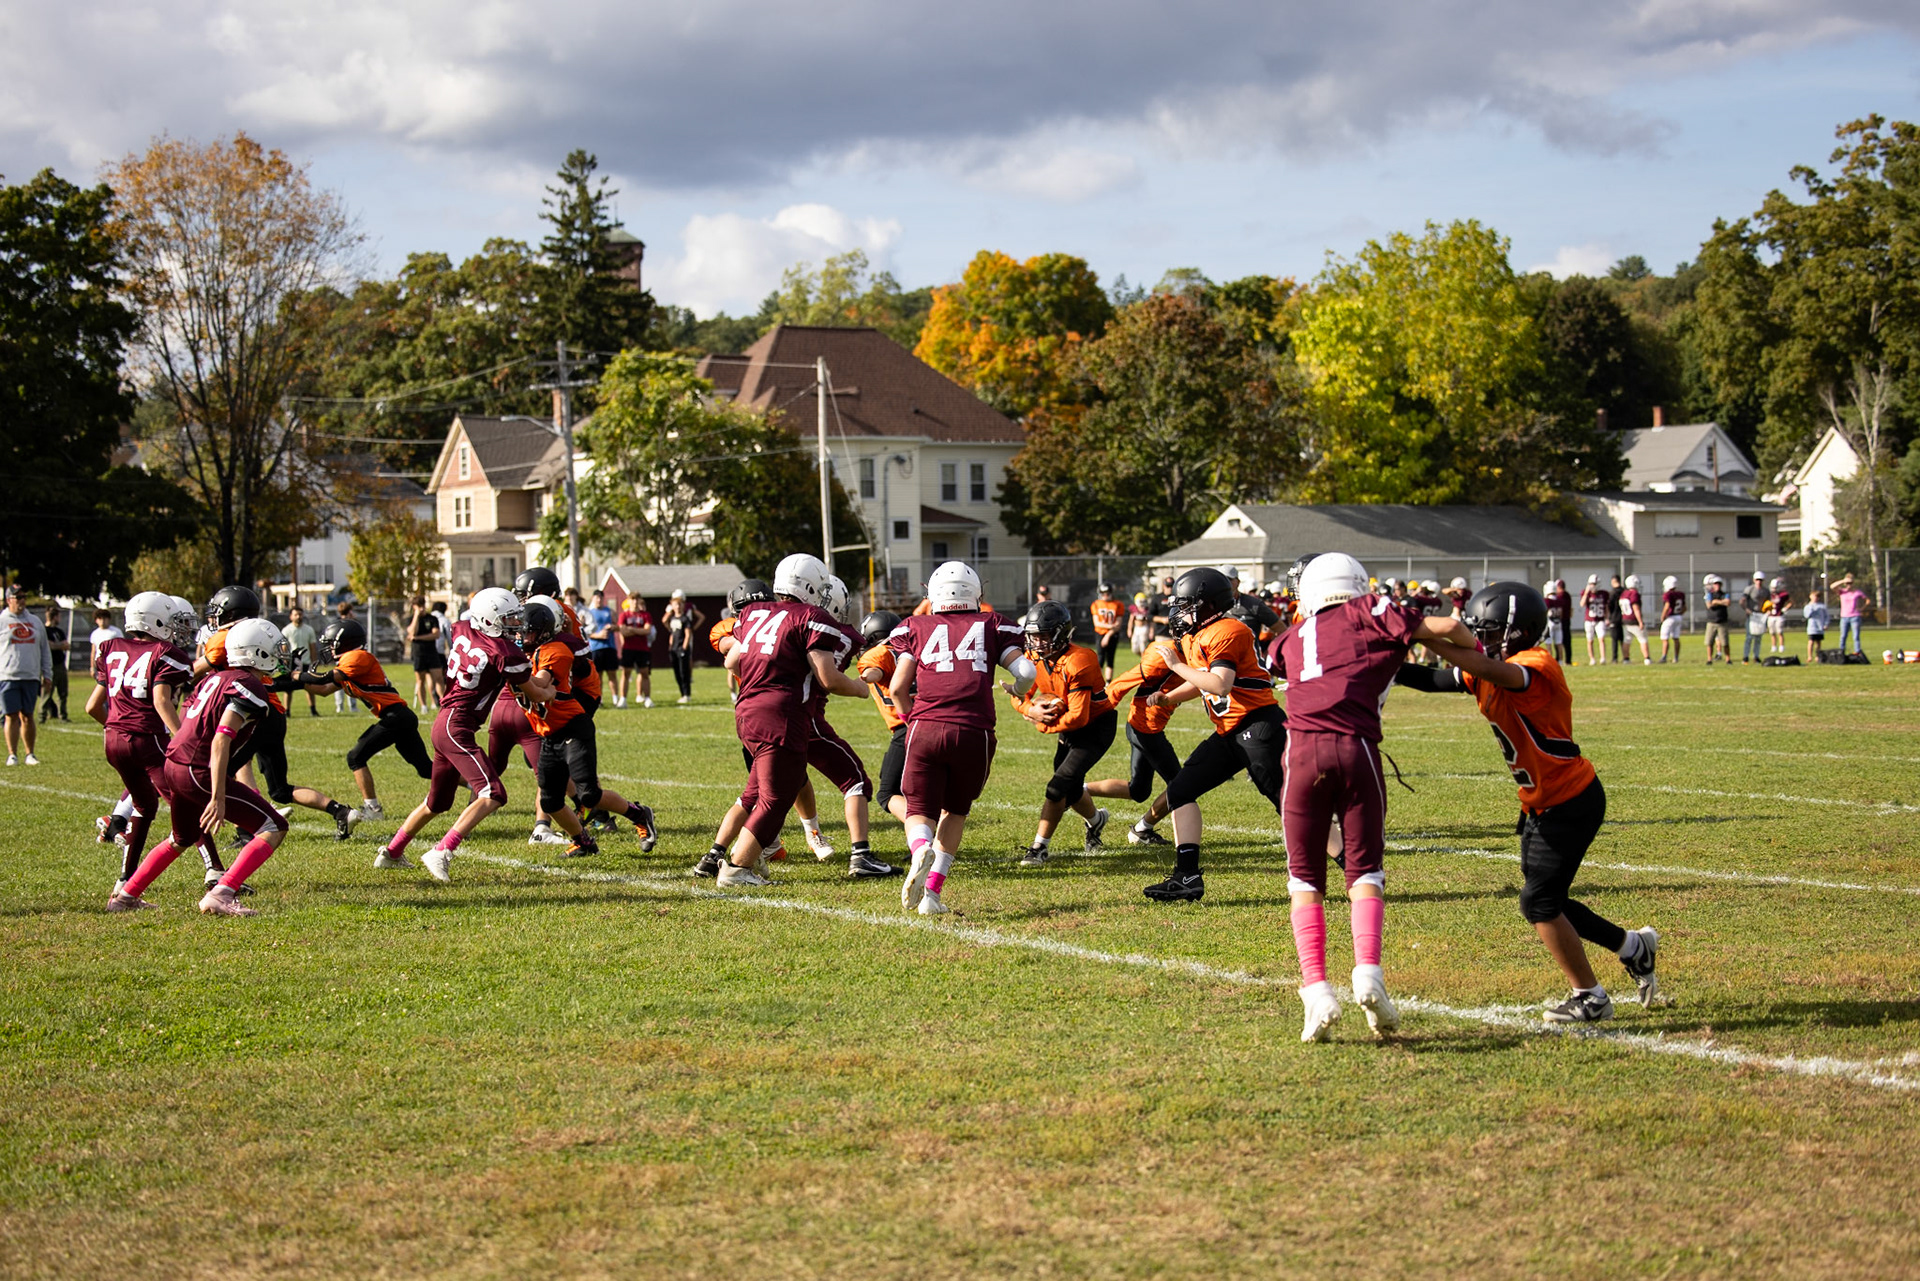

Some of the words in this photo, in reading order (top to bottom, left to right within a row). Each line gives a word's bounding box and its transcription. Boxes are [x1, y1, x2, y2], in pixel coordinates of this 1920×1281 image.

[941, 603, 968, 611] Riddell
[1674, 599, 1683, 614] 2
[740, 609, 789, 655] 74
[920, 621, 988, 673] 44
[1298, 616, 1323, 682] 1
[105, 651, 153, 699] 34
[446, 634, 489, 690] 63
[186, 676, 221, 719] 9
